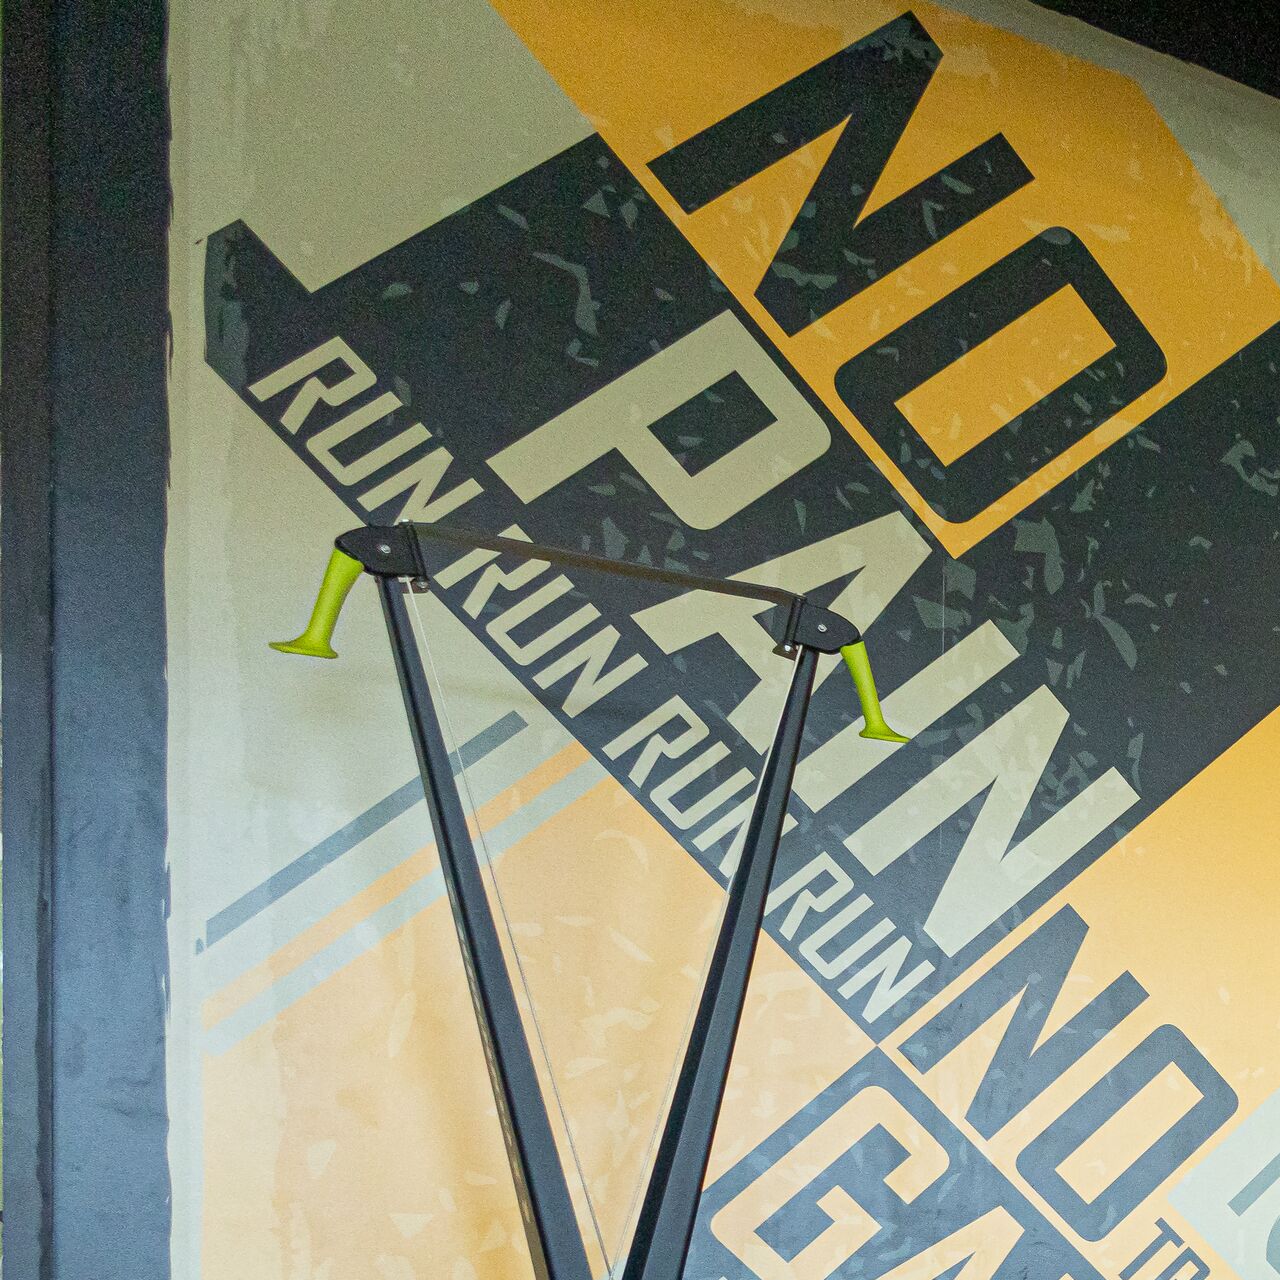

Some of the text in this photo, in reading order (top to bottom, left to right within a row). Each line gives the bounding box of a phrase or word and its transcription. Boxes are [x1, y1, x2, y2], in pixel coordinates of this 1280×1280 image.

[646, 10, 1168, 524] NO
[248, 336, 485, 525] RUN
[434, 523, 649, 718] RUN
[764, 851, 936, 1024] RUN
[485, 308, 1141, 958] PAIN
[897, 903, 1239, 1242] NO
